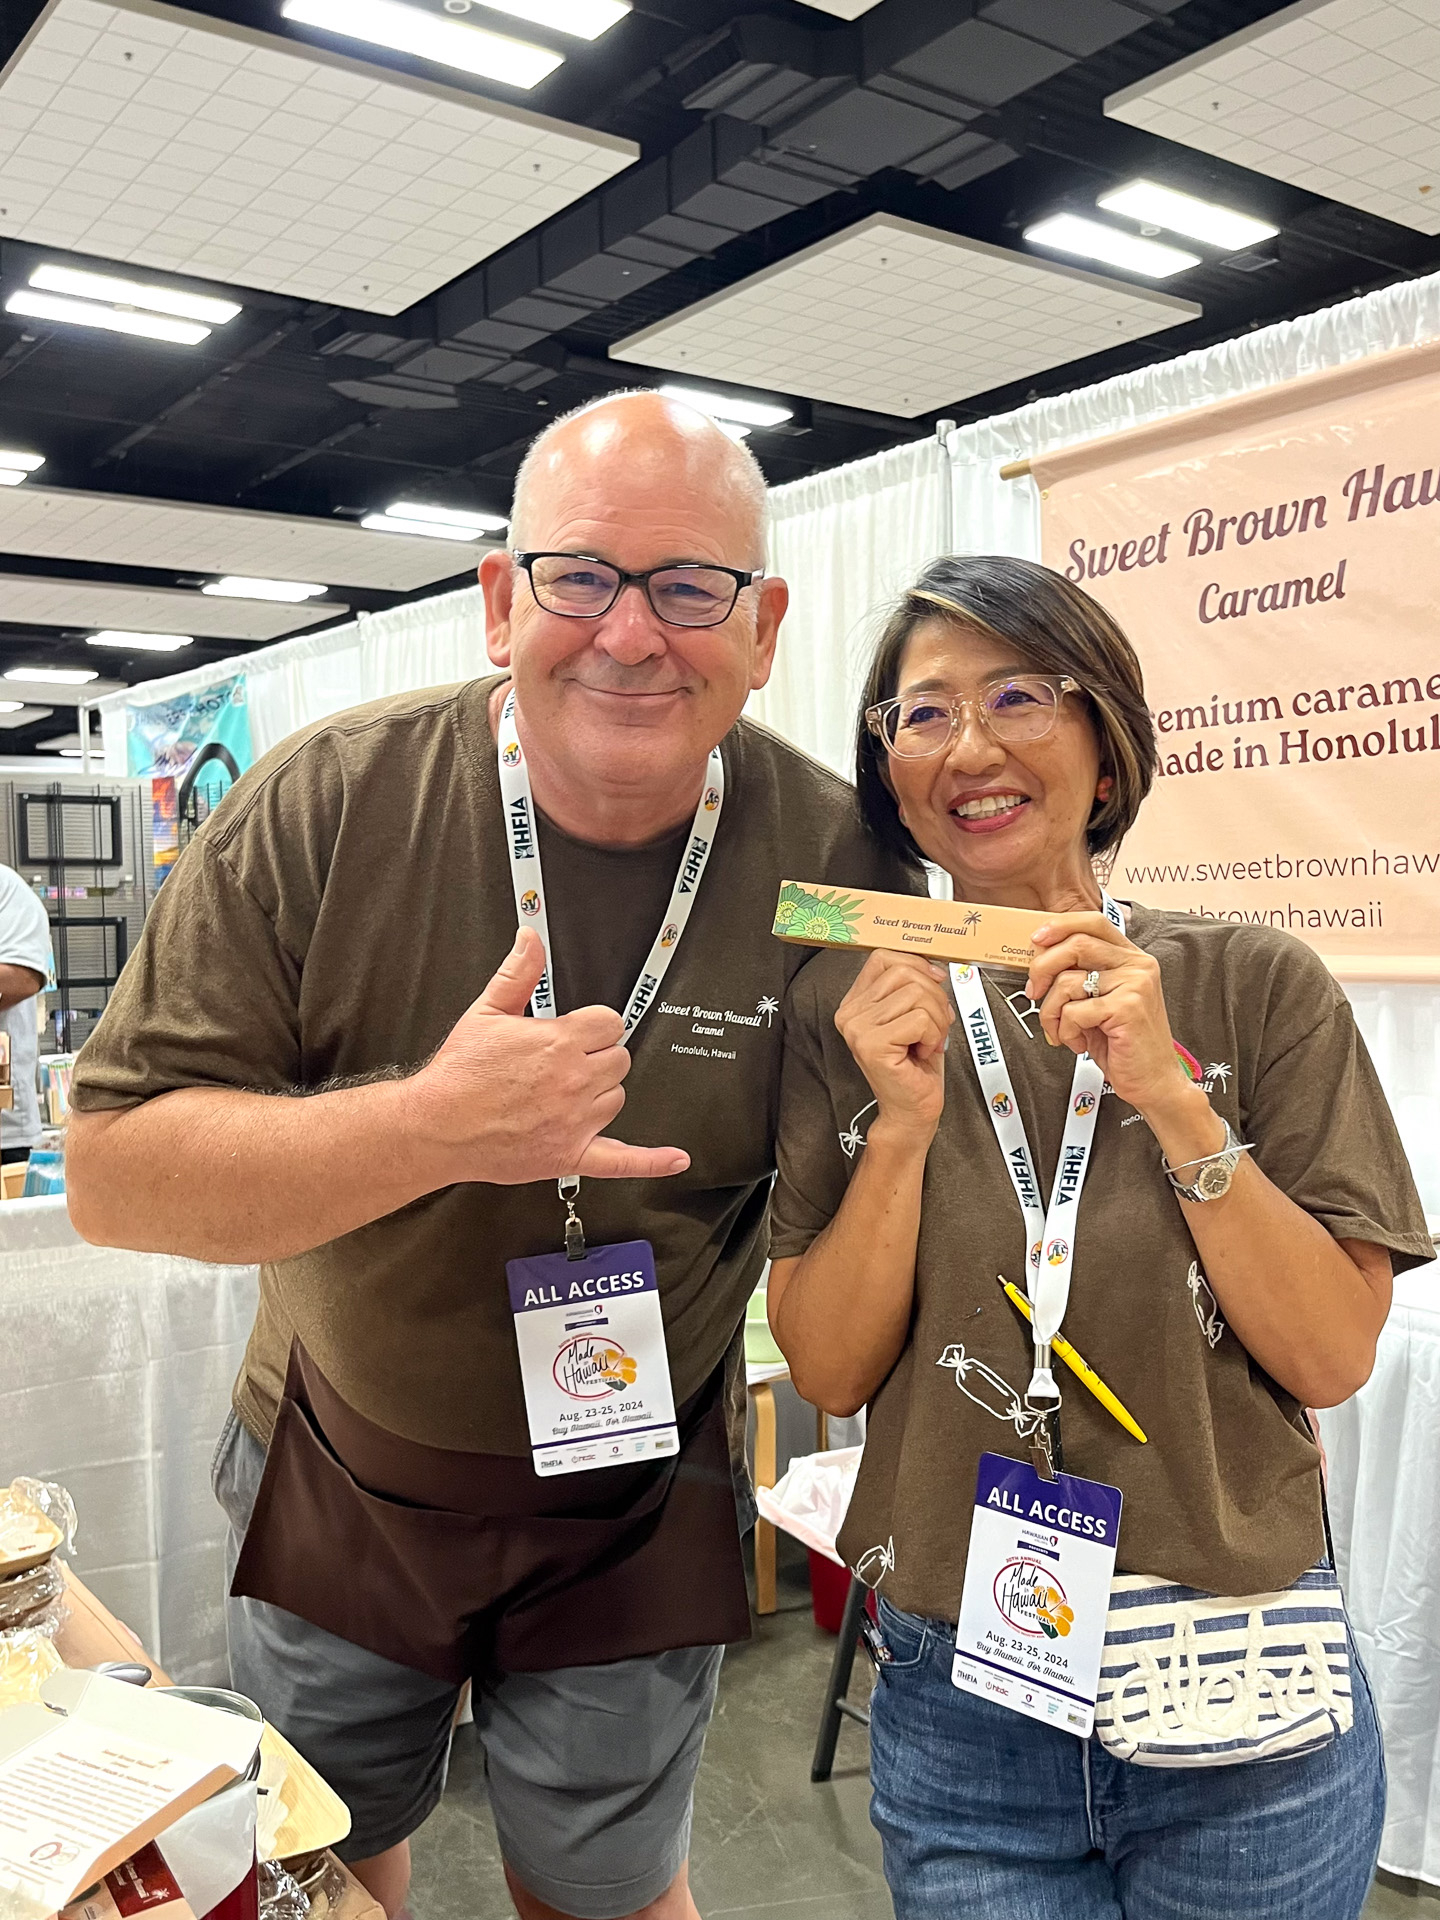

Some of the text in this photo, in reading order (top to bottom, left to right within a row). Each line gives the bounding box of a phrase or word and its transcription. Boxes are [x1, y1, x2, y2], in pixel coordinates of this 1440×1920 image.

[1064, 523, 1170, 584] Sweet
[1183, 495, 1327, 557] Brown
[1199, 559, 1347, 624] Caramel
[1151, 694, 1284, 733] emium
[1233, 736, 1270, 769] in
[1279, 714, 1440, 765] Honolul
[510, 797, 531, 845] HFIA
[678, 850, 706, 894] HFIA
[1125, 849, 1440, 883] www.sweetbrownhaw
[873, 915, 968, 936] Sweet Brown Hawaii
[902, 932, 933, 944] Caramel
[1001, 945, 1035, 957] Coconut
[624, 988, 651, 1031] HFIA
[658, 1001, 762, 1027] Sweet Brown Hawaii
[691, 1022, 724, 1037] Caramel
[968, 1007, 996, 1053] HFIA
[671, 1043, 737, 1060] Honolulu, Hawaii
[1009, 1147, 1034, 1195] HFIA
[1056, 1161, 1081, 1206] HFIA
[524, 1270, 645, 1307] ALL ACCESS
[567, 1339, 594, 1365] Made
[563, 1354, 610, 1393] Hawaii
[559, 1400, 643, 1422] Aug. 23-25, 2024
[987, 1487, 1107, 1539] ALL ACCESS
[1010, 1561, 1038, 1588] Made
[1002, 1583, 1047, 1617] Hawaii
[1020, 1609, 1050, 1625] FESTIVAL
[976, 1641, 992, 1655] Buy
[1027, 1661, 1041, 1673] For
[986, 1630, 1068, 1668] Aug. 23-25, 2024
[1112, 1608, 1353, 1744] aloha
